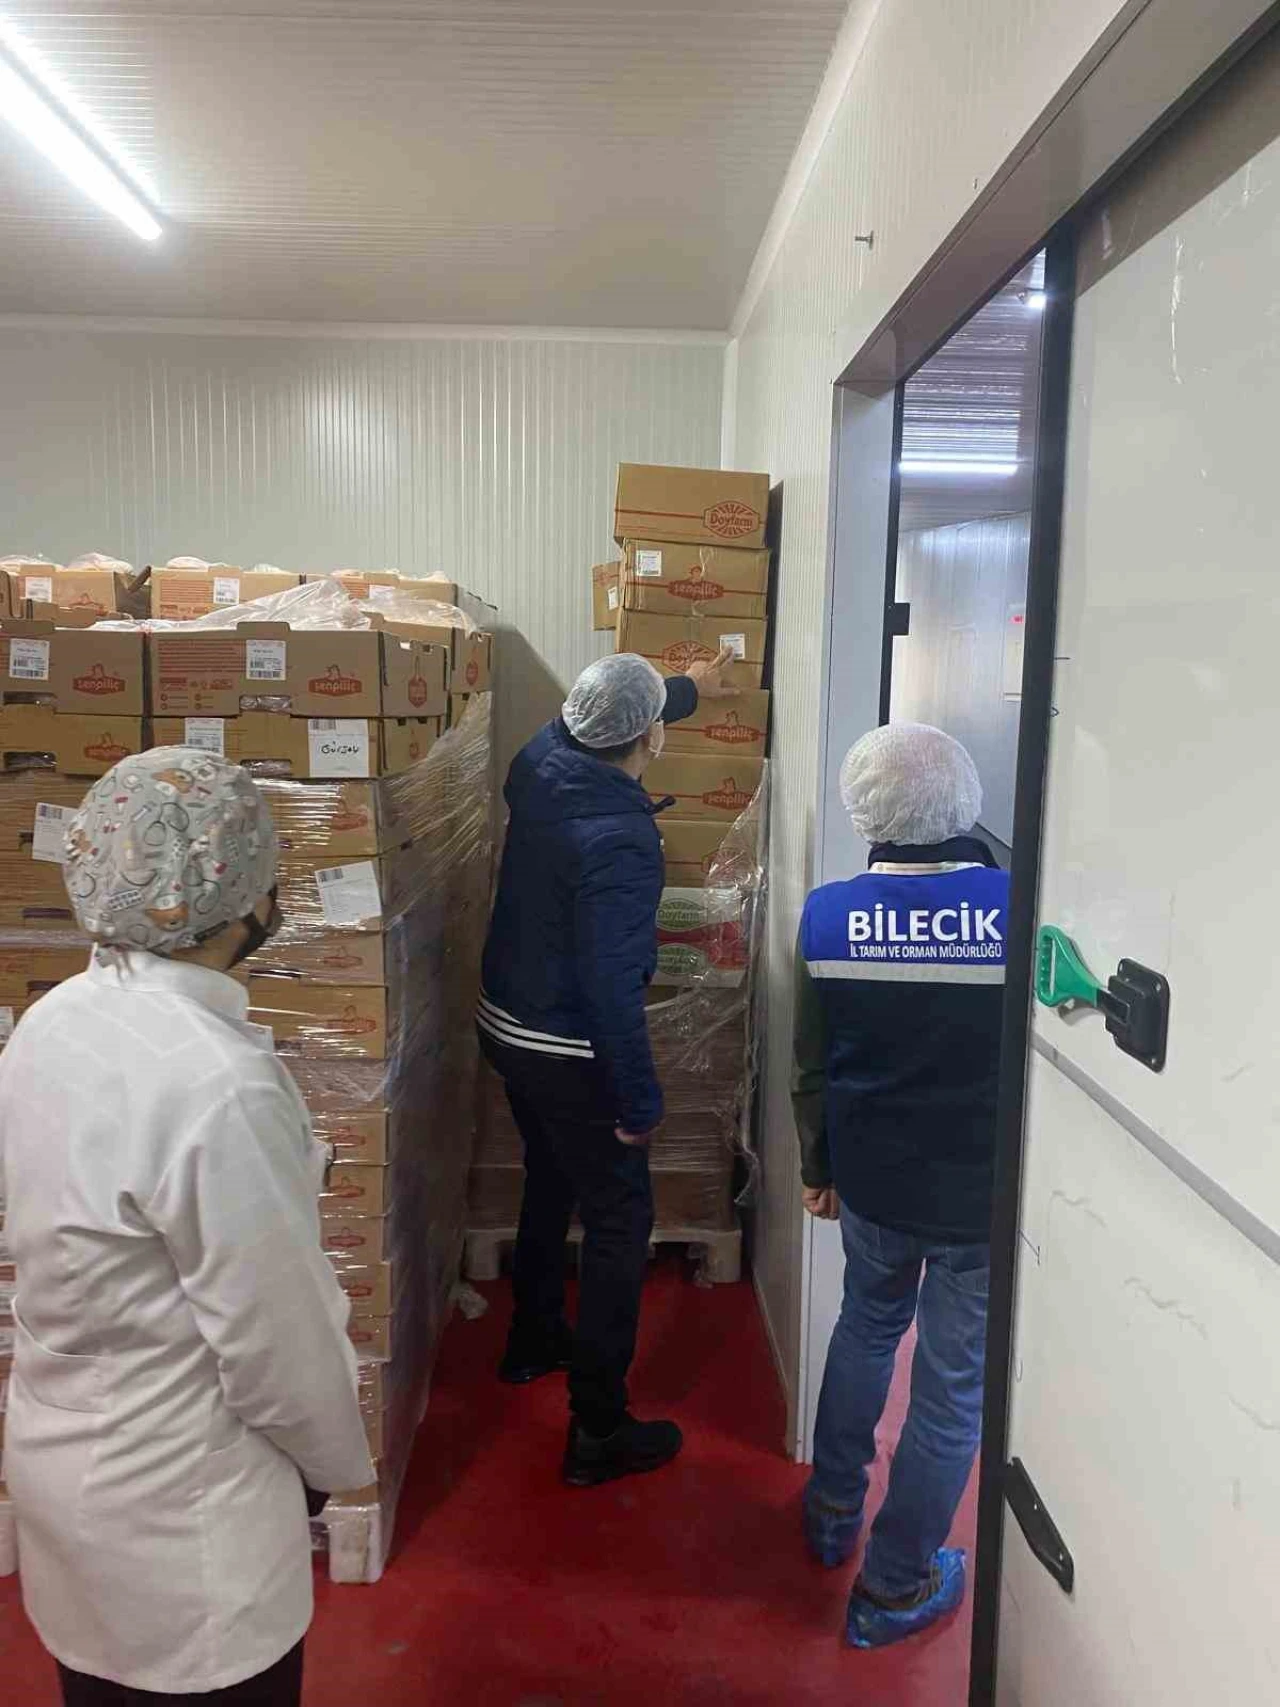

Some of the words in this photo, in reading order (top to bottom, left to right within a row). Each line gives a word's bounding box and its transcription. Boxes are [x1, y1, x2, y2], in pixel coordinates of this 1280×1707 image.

[848, 901, 1003, 942] BİLECİK
[850, 944, 859, 958] İL
[860, 946, 887, 958] TARIM
[889, 946, 900, 957] VE
[902, 946, 938, 958] ORMAN
[939, 943, 1002, 958] MÜDÜRLÜĞÜ
